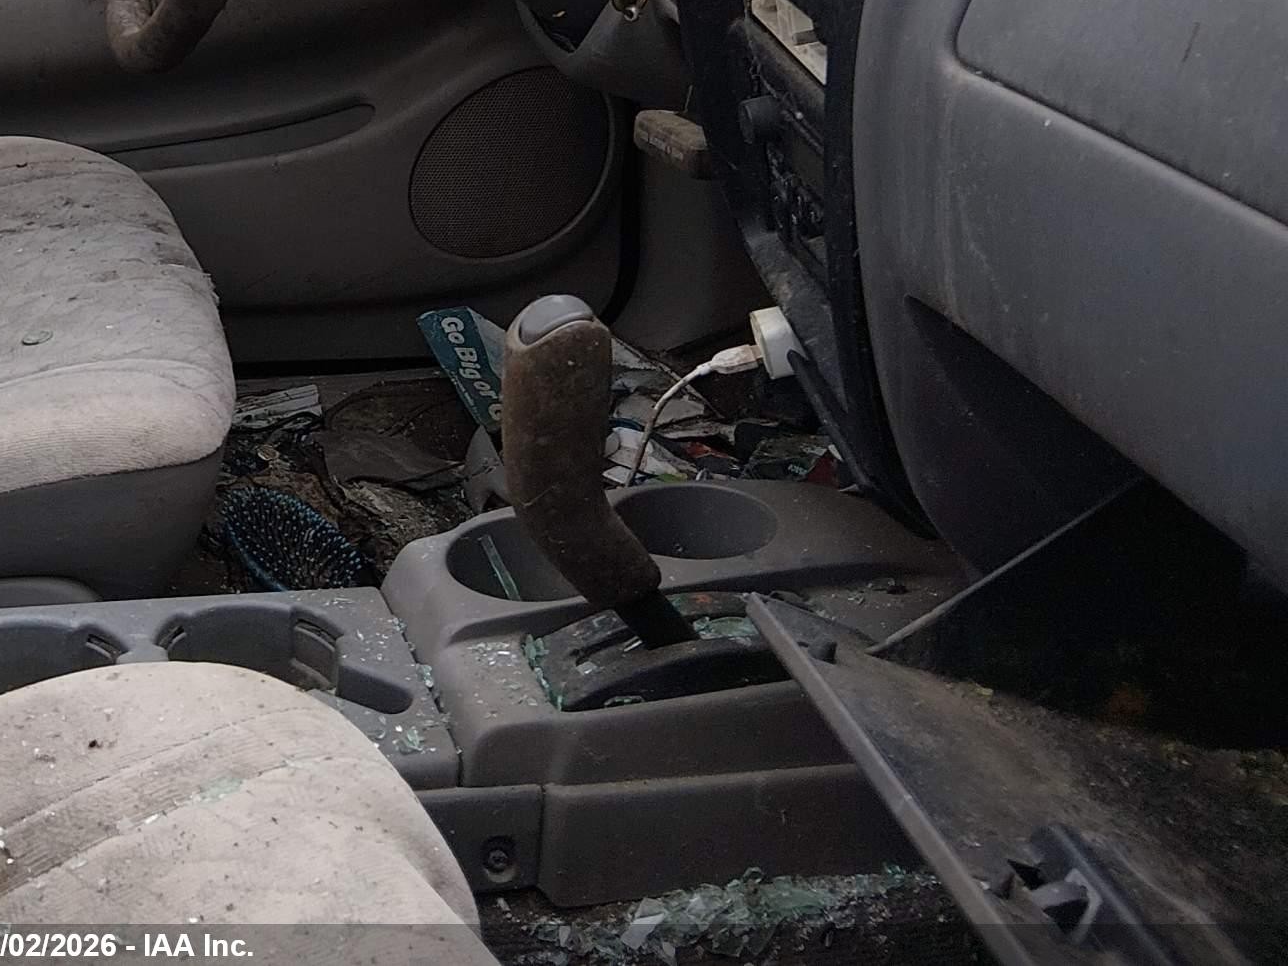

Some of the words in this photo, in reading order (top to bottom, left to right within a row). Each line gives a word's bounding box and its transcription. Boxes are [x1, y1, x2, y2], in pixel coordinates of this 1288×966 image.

[441, 317, 464, 344] Go
[454, 347, 481, 379] Big
[473, 381, 499, 399] or
